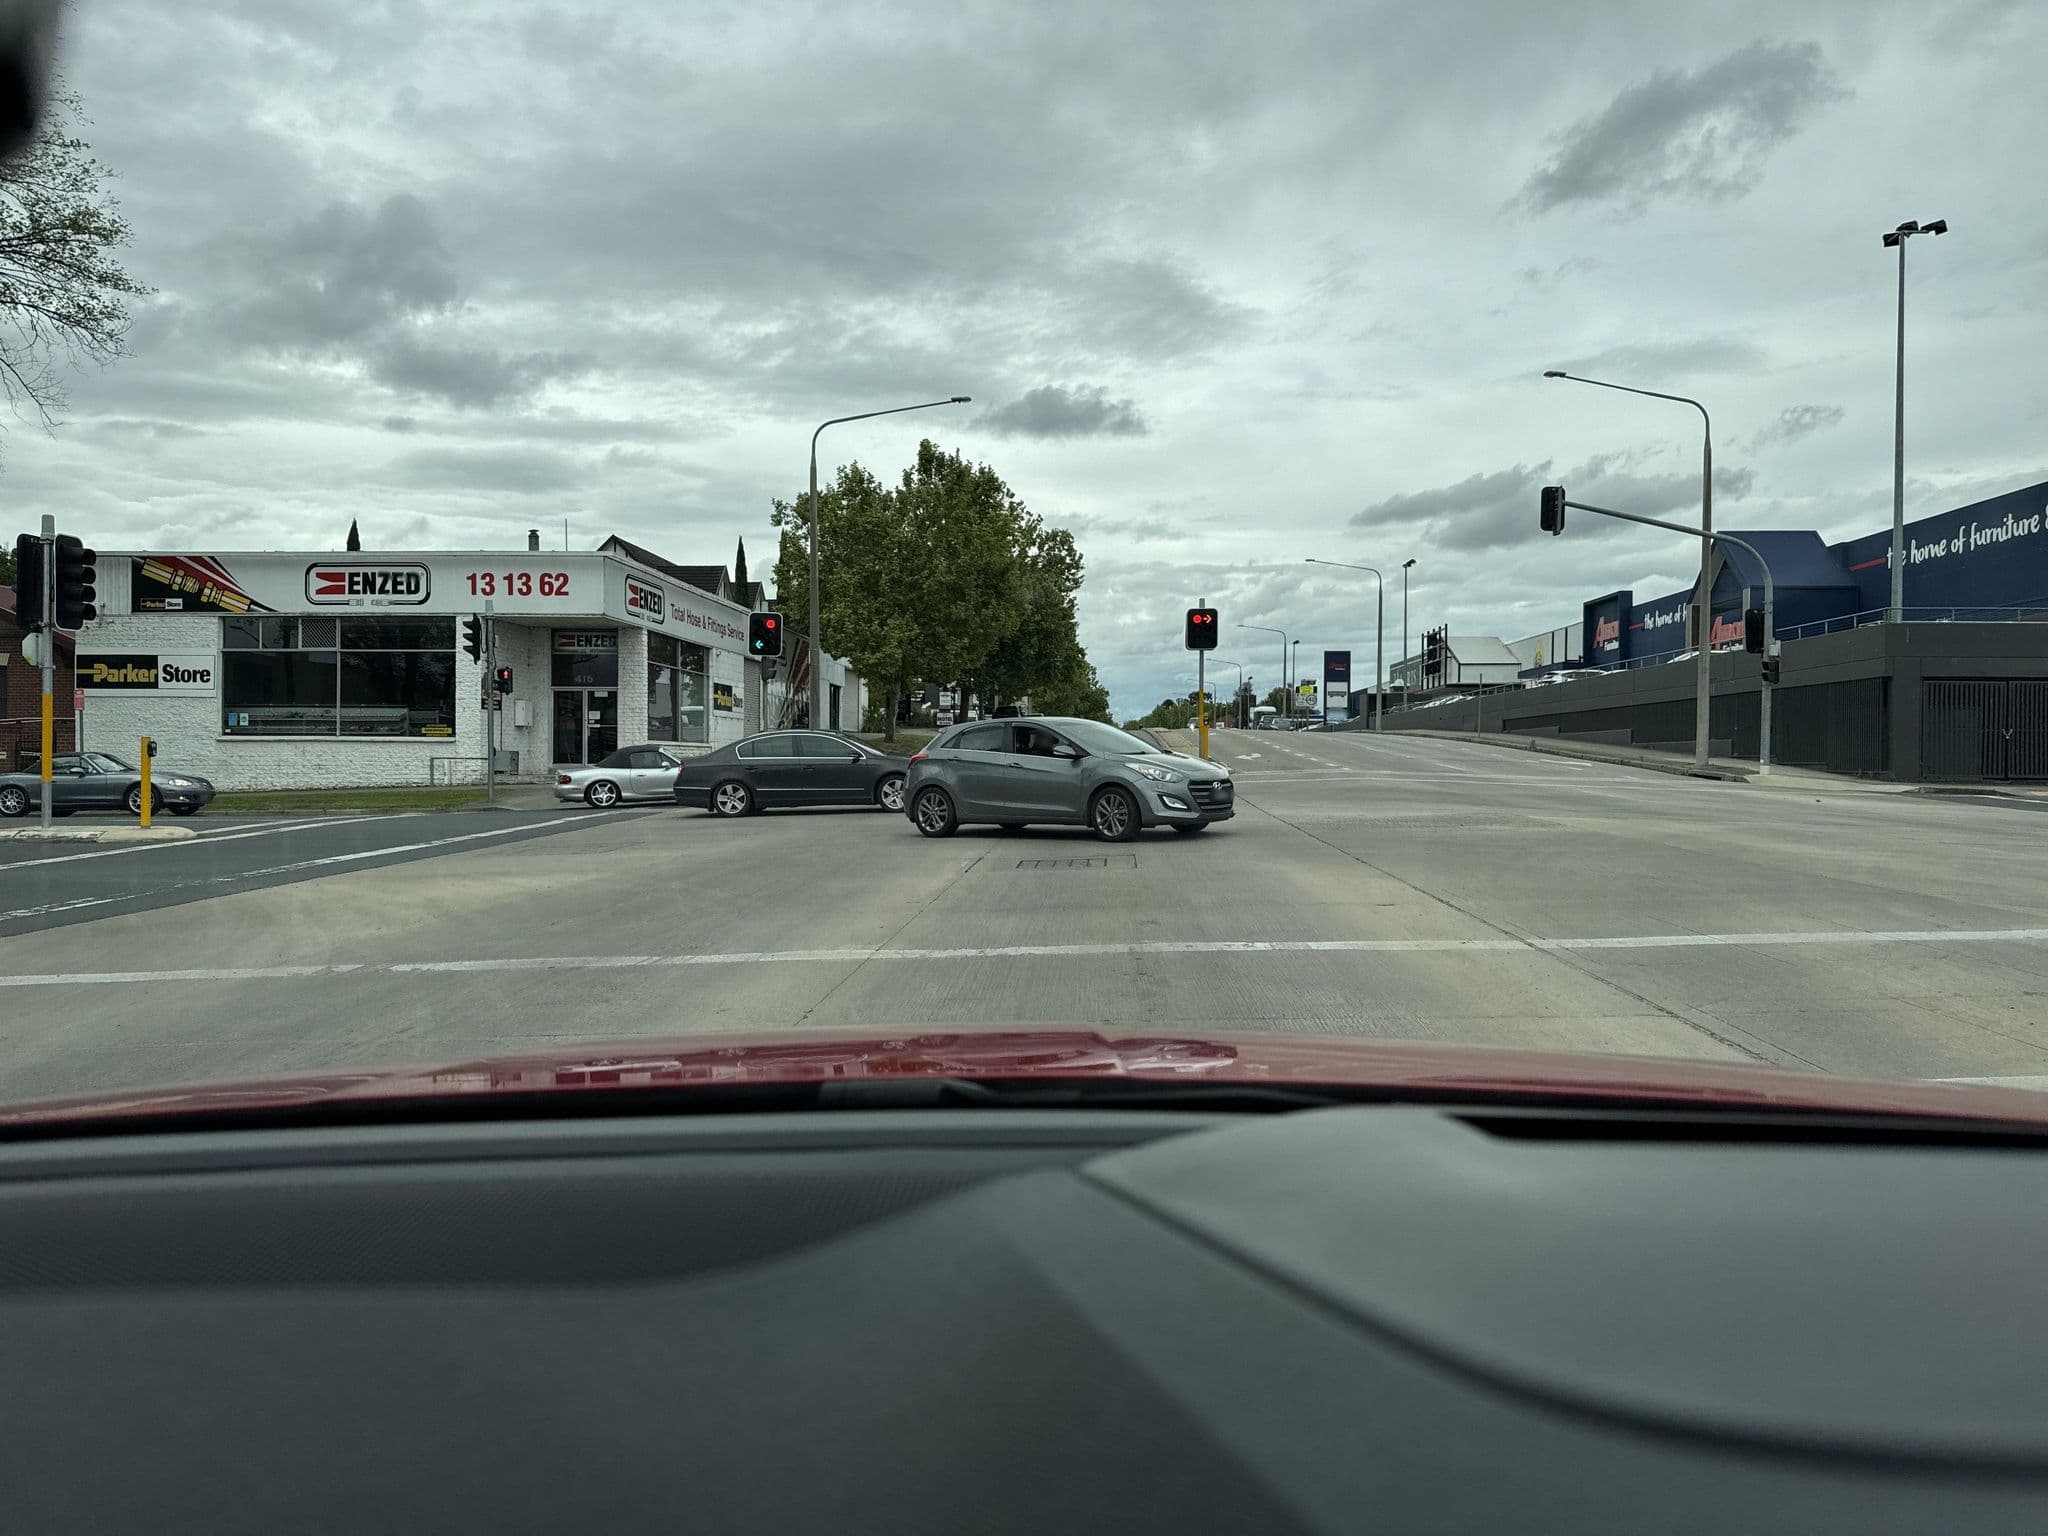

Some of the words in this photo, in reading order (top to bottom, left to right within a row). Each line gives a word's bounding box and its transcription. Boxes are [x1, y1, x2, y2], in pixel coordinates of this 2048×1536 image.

[1910, 539, 1947, 564] home
[1951, 526, 1966, 554] of
[1970, 513, 2040, 551] furniture
[348, 572, 420, 595] ENZED
[466, 572, 495, 596] 13
[503, 572, 532, 596] 13
[539, 572, 569, 596] 62
[639, 587, 662, 615] ENZED
[670, 603, 686, 622] Total
[686, 609, 701, 628] Hose
[707, 616, 727, 638] Fittings
[727, 623, 745, 642] Service
[1655, 610, 1673, 628] home
[1673, 604, 1682, 624] of
[576, 634, 617, 648] ENZED
[93, 663, 157, 682] Parker
[162, 664, 211, 683] Store
[576, 674, 593, 683] 416
